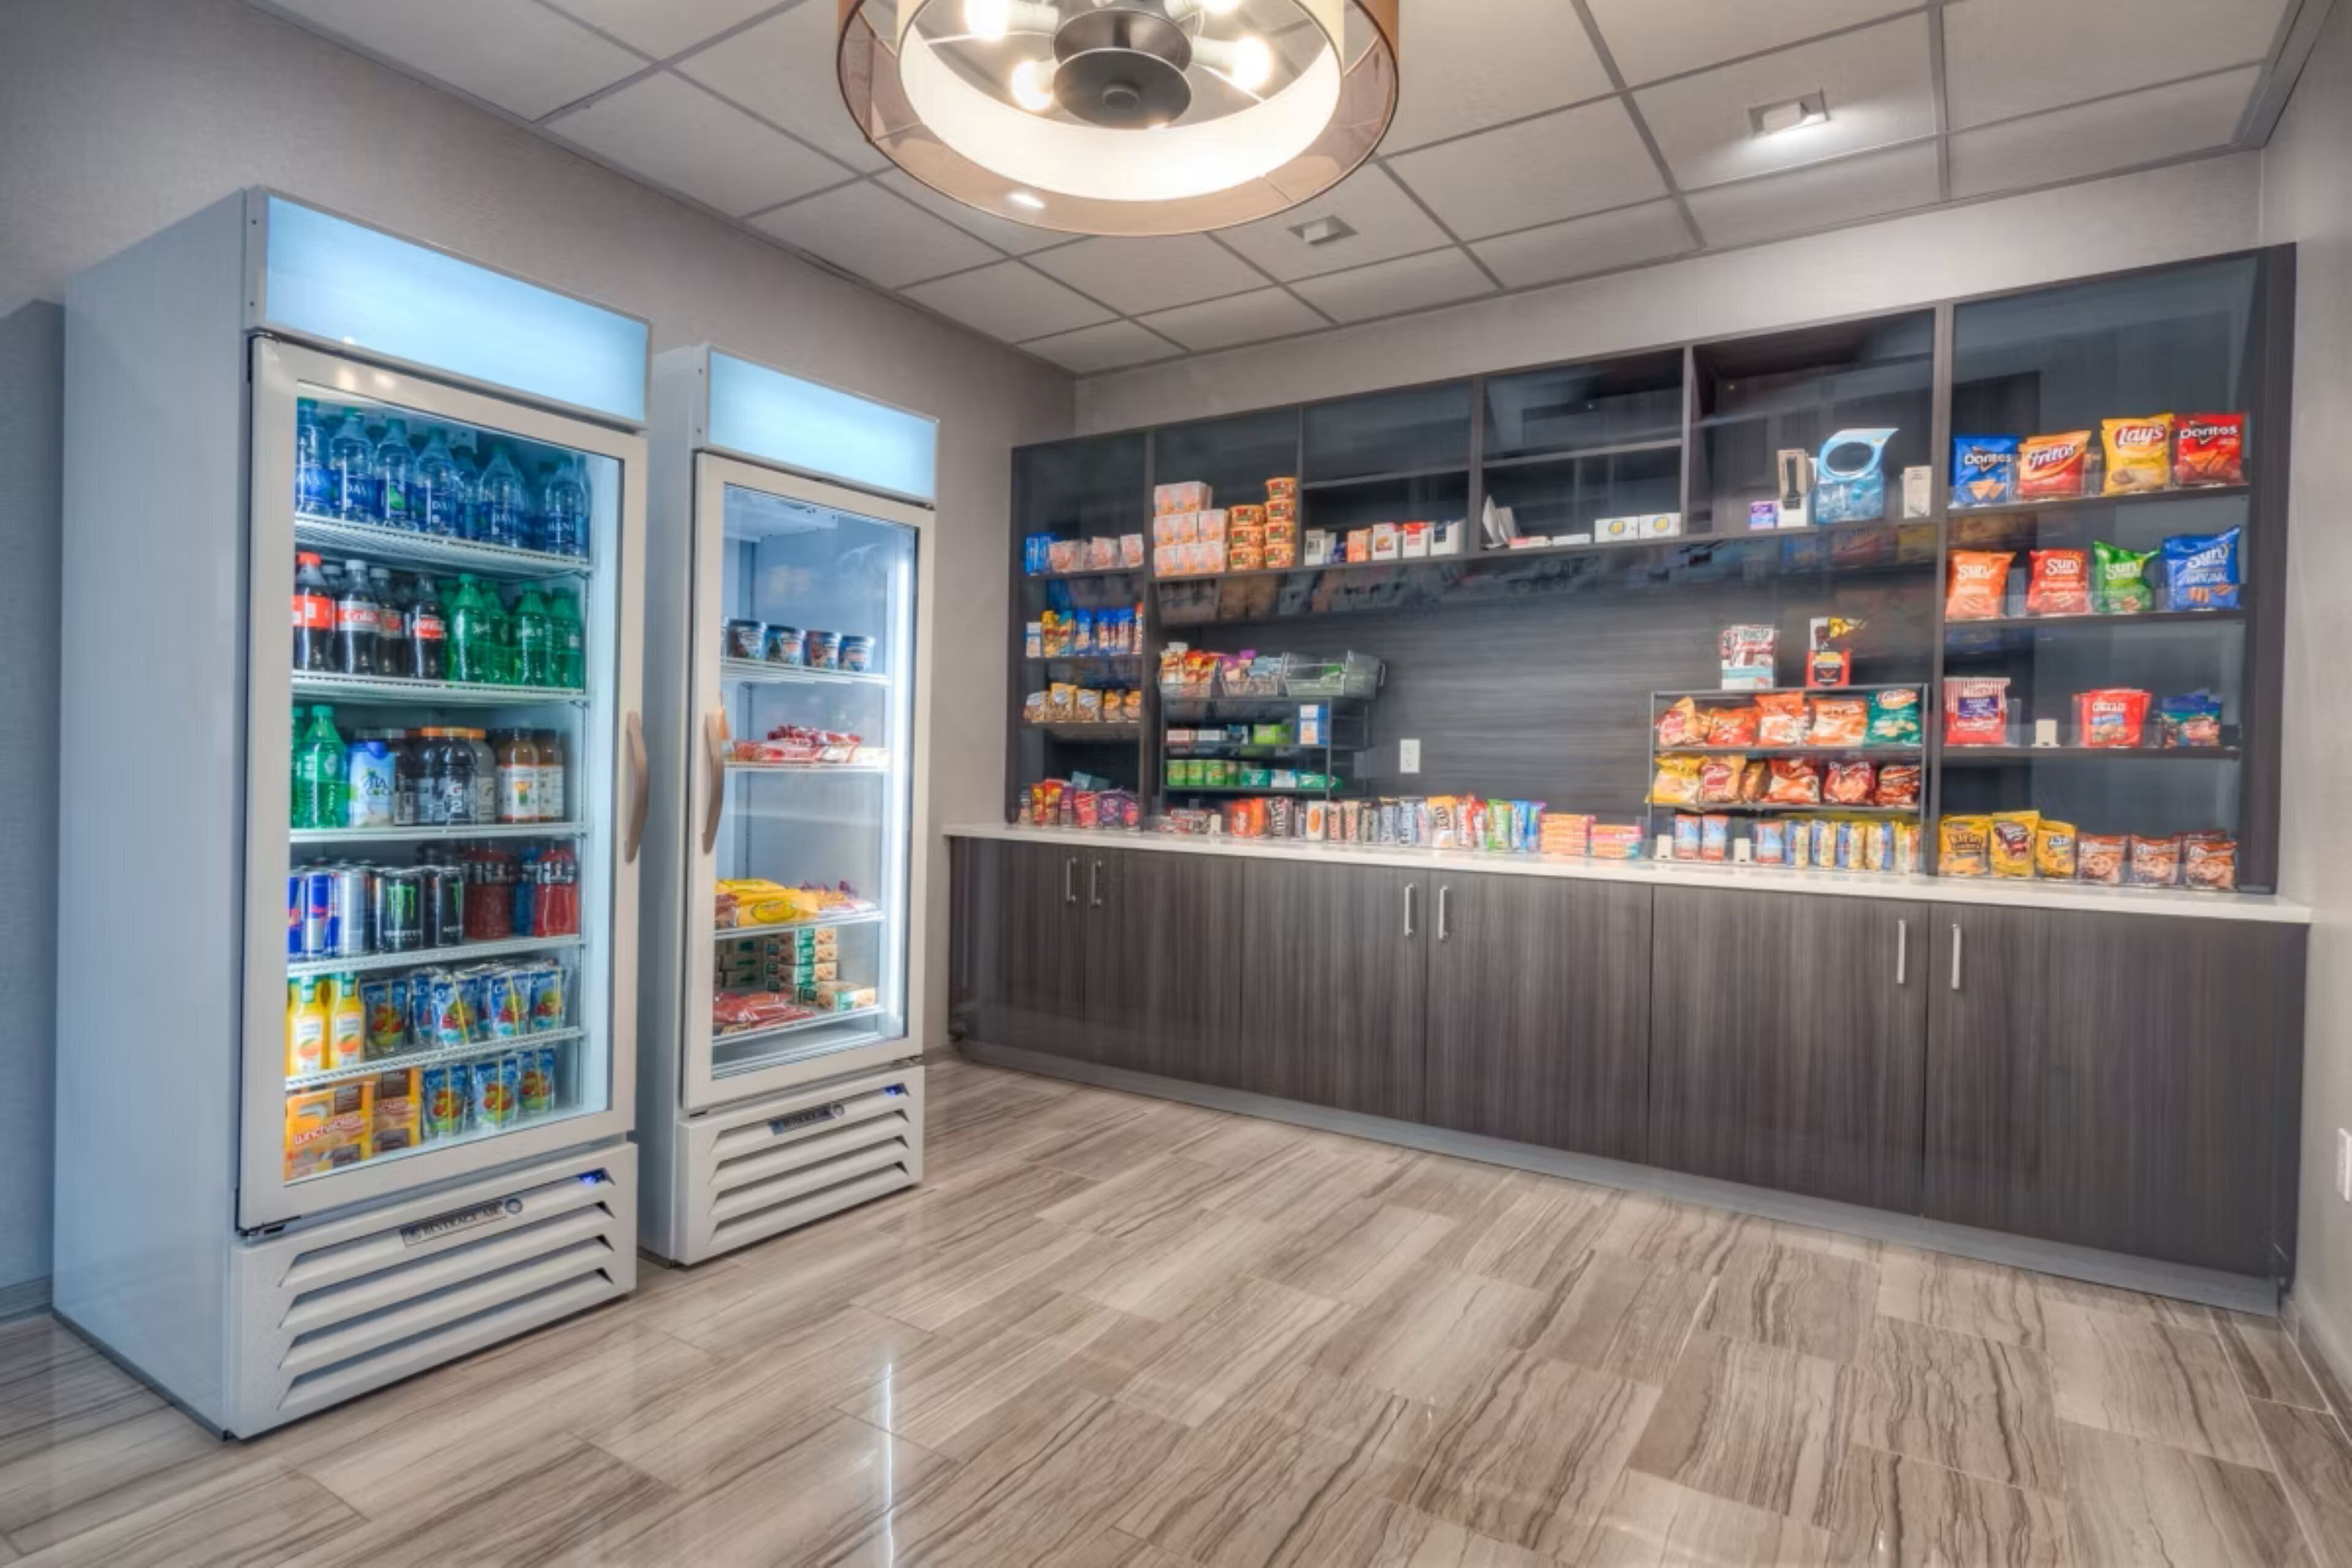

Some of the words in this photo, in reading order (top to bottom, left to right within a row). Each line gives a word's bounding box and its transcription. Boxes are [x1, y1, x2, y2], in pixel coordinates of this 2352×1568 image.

[2117, 423, 2165, 446] Lay's
[2179, 426, 2237, 439] Doritos
[1964, 453, 2011, 466] Doritos
[2029, 444, 2075, 469] Fritos
[1957, 564, 1990, 581] Sun
[2045, 557, 2079, 576] Sun
[2106, 562, 2139, 580] Sun
